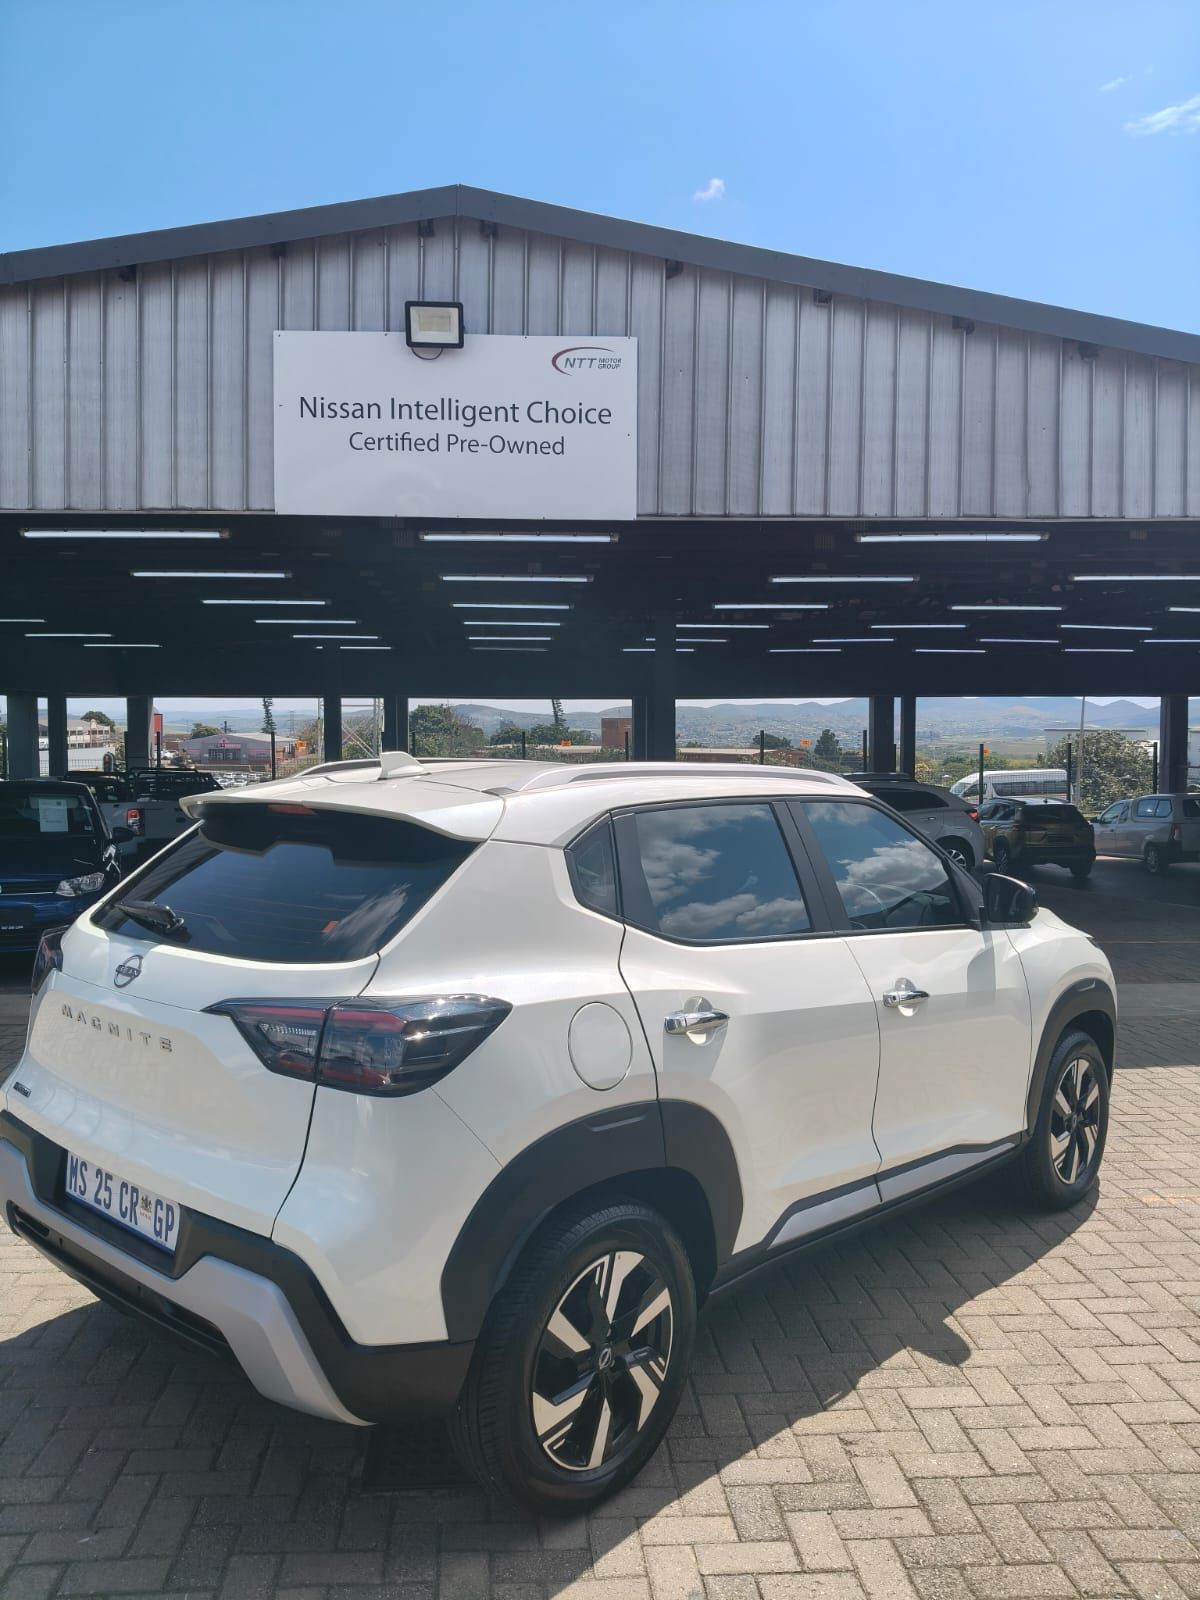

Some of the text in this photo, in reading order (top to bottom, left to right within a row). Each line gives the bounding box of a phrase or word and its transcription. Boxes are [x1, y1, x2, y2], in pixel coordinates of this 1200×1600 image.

[564, 357, 597, 369] NTT
[299, 396, 613, 428] Nissan Intelligent Choice
[349, 431, 565, 456] Certified Pre-Owned
[61, 1003, 173, 1053] MAGNITE
[68, 1155, 175, 1242] MS 25 CR GP
